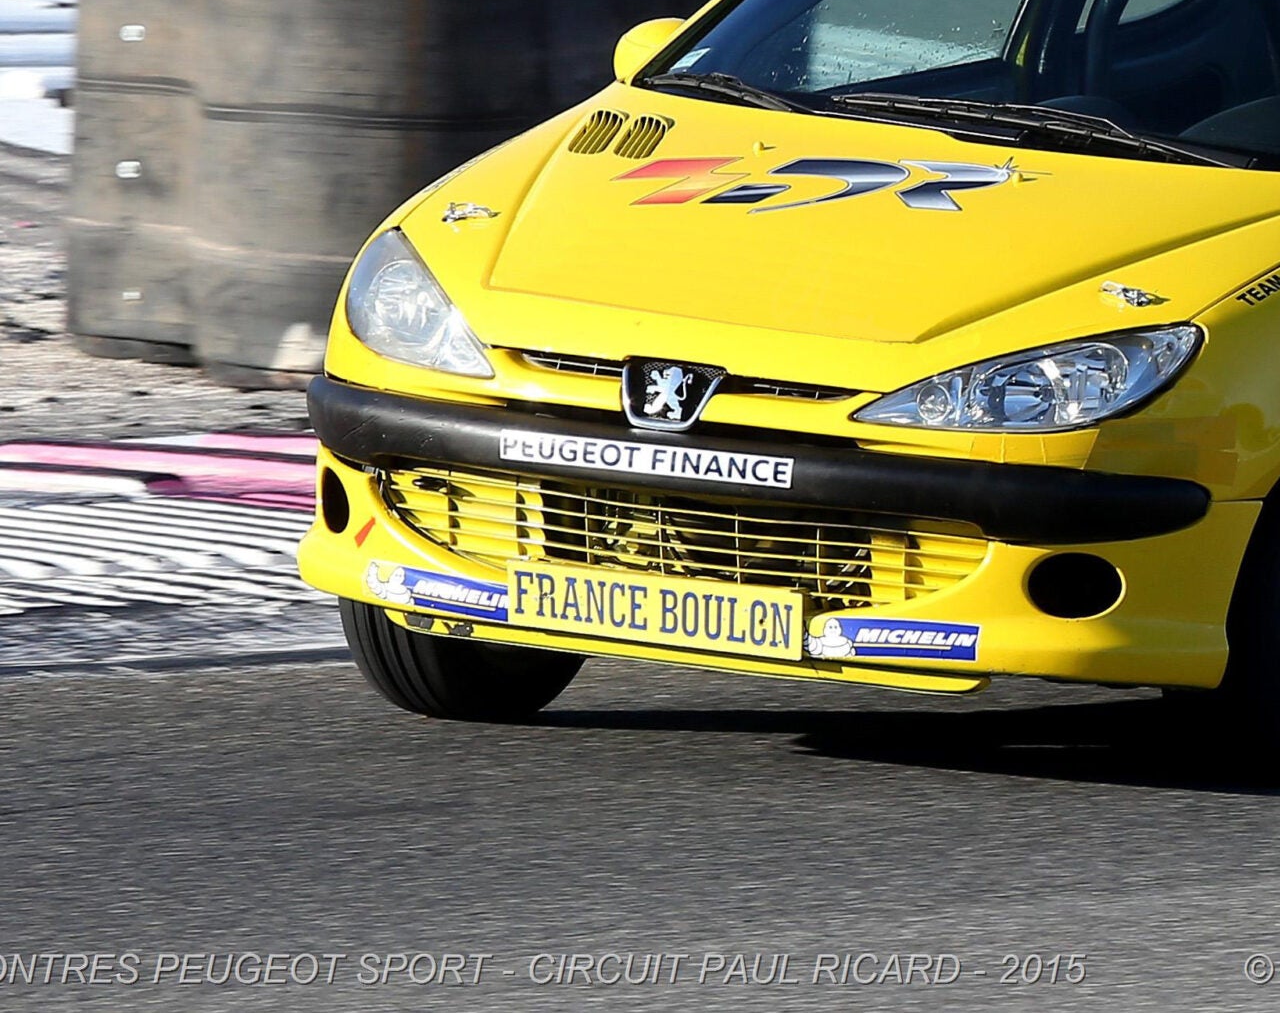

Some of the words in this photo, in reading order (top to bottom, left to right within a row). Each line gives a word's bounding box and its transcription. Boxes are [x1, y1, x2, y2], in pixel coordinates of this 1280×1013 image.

[502, 437, 641, 469] PEUGEOT
[651, 448, 790, 485] FINANCE
[514, 570, 648, 631] FRANCE
[854, 627, 978, 649] MICHELIN
